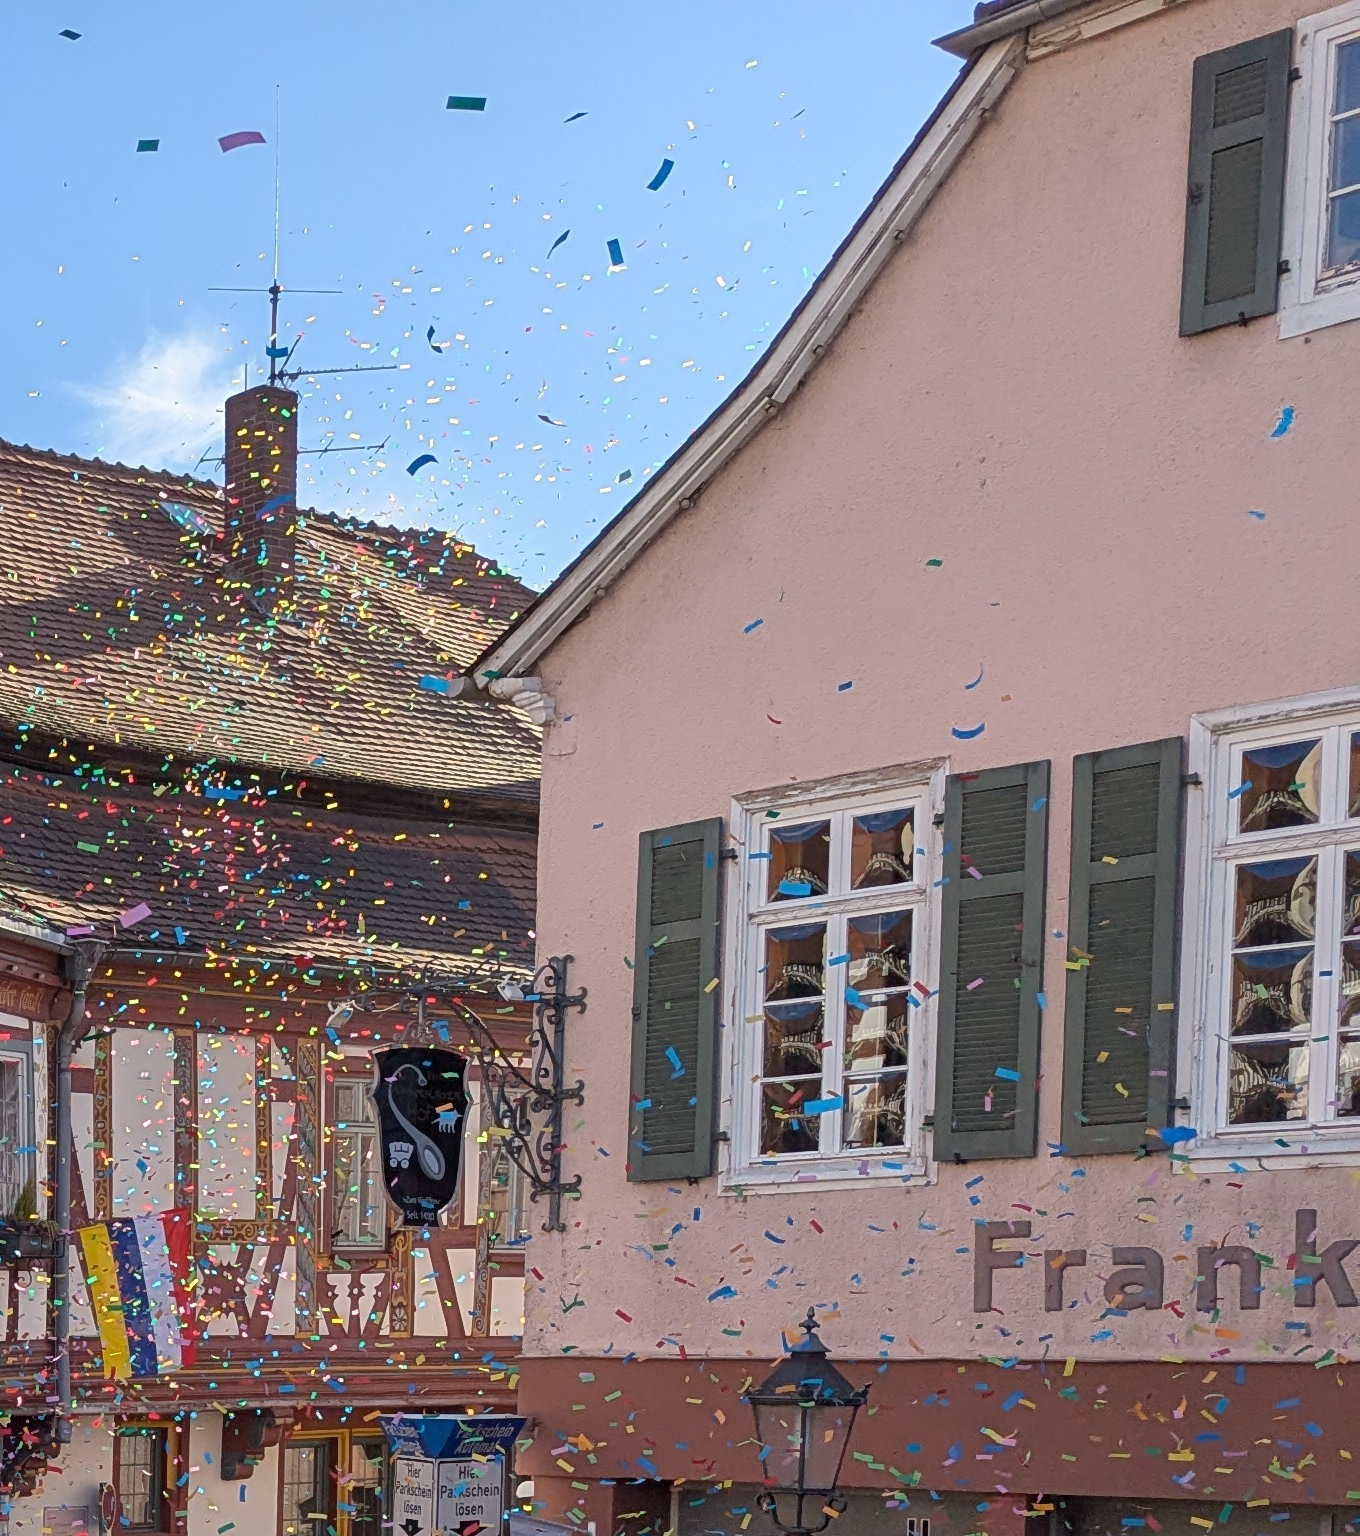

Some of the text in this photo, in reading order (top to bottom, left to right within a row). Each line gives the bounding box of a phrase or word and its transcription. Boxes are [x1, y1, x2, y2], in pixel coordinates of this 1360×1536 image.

[973, 1208, 1360, 1313] Frank
[407, 1464, 421, 1479] Hier
[395, 1483, 432, 1500] Parkschein
[440, 1484, 500, 1500] Paschein
[454, 1501, 484, 1516] lösen
